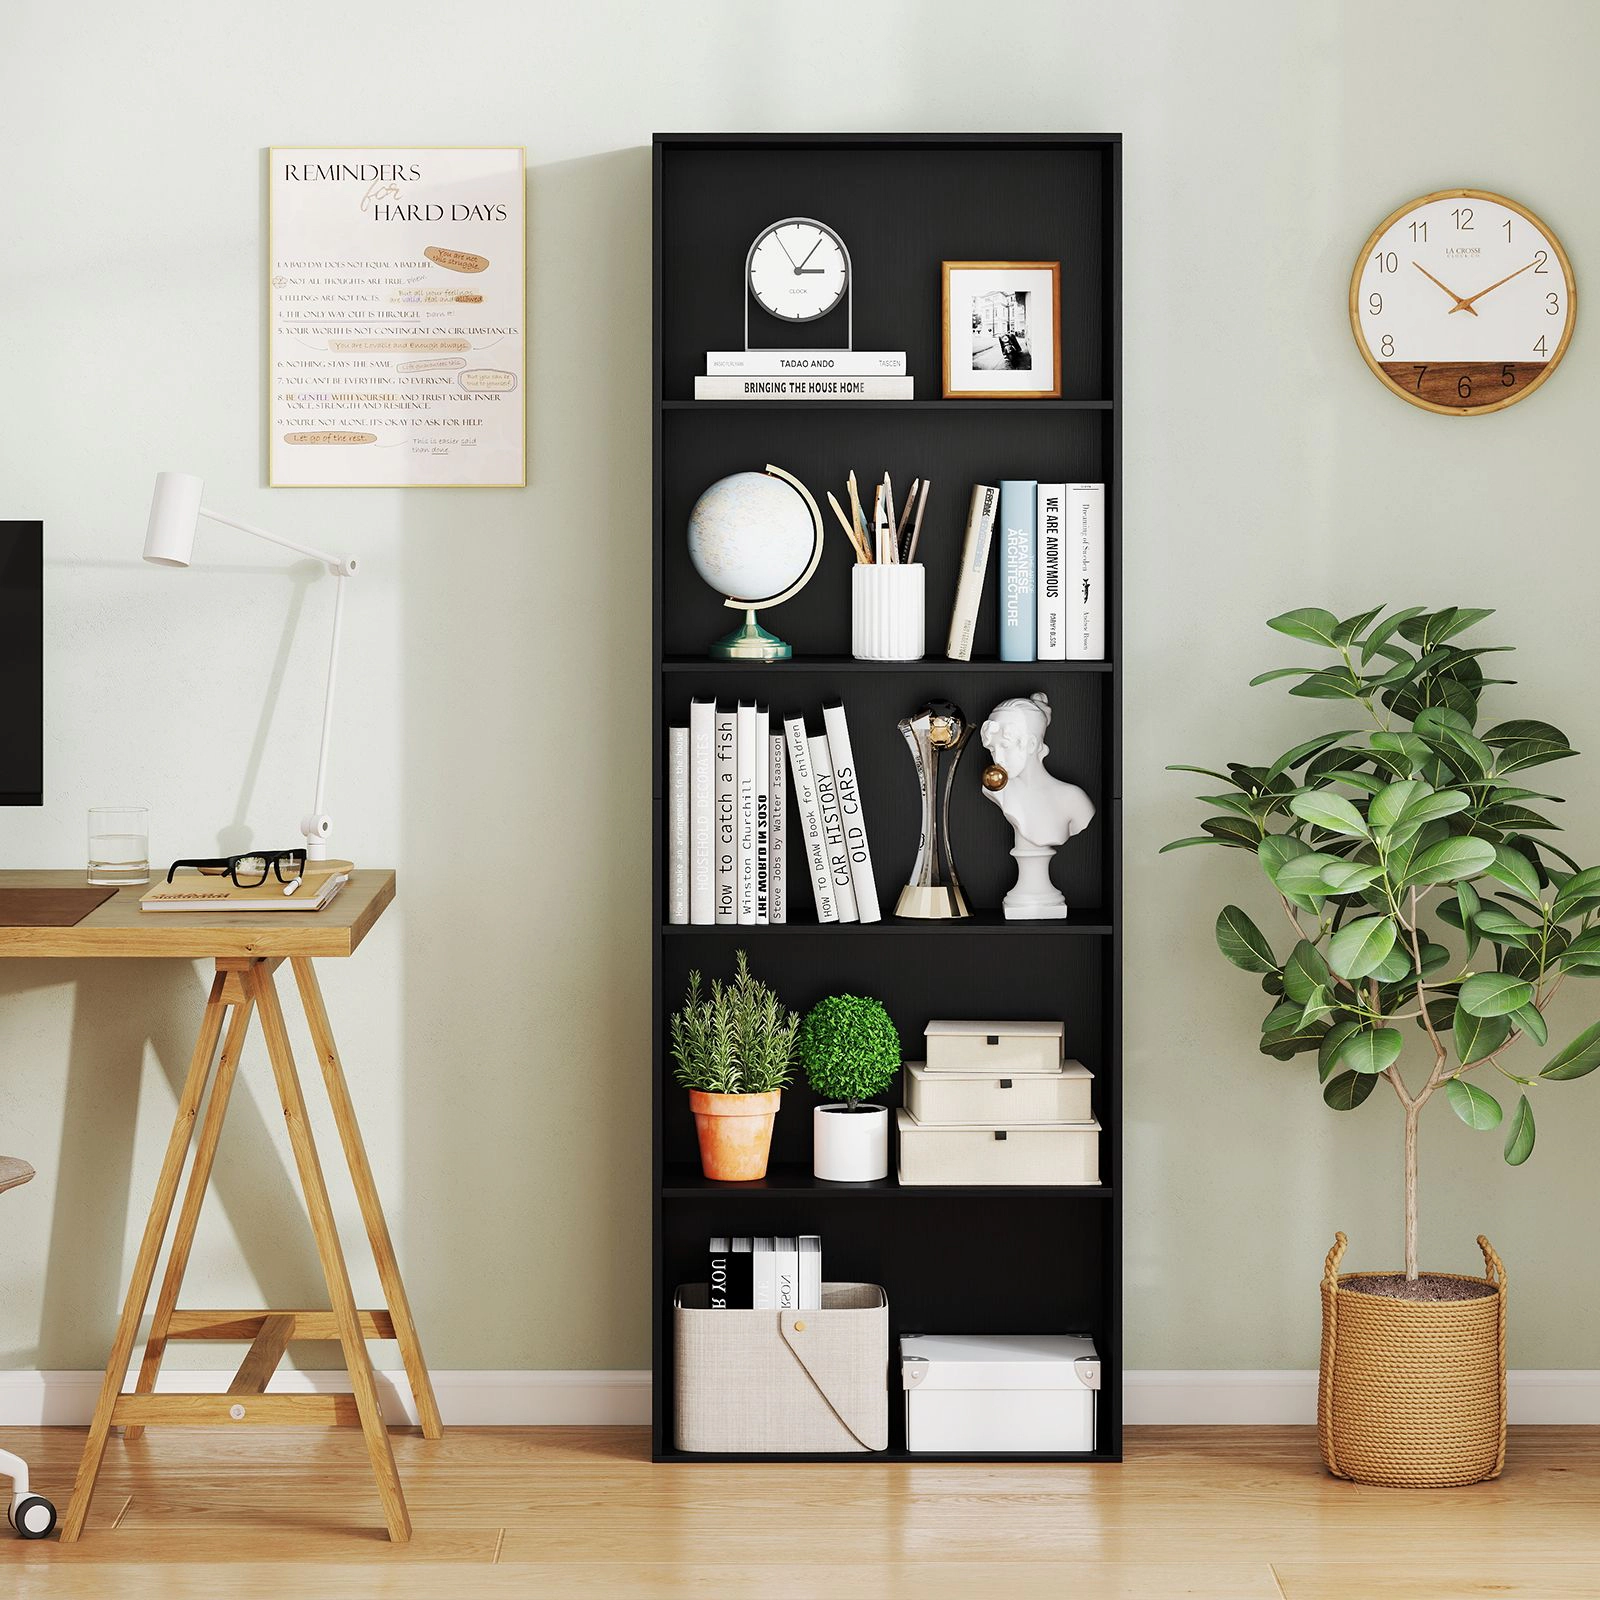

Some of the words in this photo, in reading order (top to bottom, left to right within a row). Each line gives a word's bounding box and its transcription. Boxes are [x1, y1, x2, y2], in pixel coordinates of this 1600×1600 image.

[285, 164, 421, 182] REMINDERS
[360, 180, 404, 212] for
[375, 204, 444, 222] HARD
[451, 204, 508, 222] DAYS
[1451, 208, 1475, 230] 12
[1408, 221, 1427, 243] 11
[1502, 220, 1512, 243] 1
[1374, 252, 1399, 274] 10
[1533, 250, 1549, 274] 2
[1369, 292, 1383, 316] 9
[1545, 292, 1560, 316] 3
[285, 327, 309, 335] YOUR
[354, 327, 372, 335] NOT
[432, 327, 446, 335] ON
[1380, 334, 1395, 357] 8
[1533, 334, 1548, 358] 4
[780, 359, 808, 368] TADAO
[810, 359, 835, 368] ANDO
[879, 359, 901, 367] TASCEN
[285, 377, 303, 385] YOU
[744, 382, 787, 393] BRINGING
[788, 382, 806, 393] THE
[808, 382, 838, 393] HOUSE
[840, 382, 865, 393] HOME
[1413, 365, 1428, 390] 7
[1457, 375, 1472, 399] 6
[1501, 364, 1515, 388] 5
[1046, 497, 1058, 513] WE
[1046, 515, 1058, 534] ARE
[1081, 504, 1090, 537] Dreaming
[1017, 529, 1029, 594] JAPANESE
[1046, 537, 1058, 598] ANONYMOUS
[1007, 528, 1018, 627] ARCHITECTURE
[718, 722, 732, 761] fish
[792, 725, 808, 778] children
[697, 734, 709, 807] DECORATES
[773, 737, 781, 787] Isaacson
[722, 773, 733, 783] a
[803, 786, 812, 803] for
[838, 767, 858, 814] CARS
[718, 793, 732, 844] catch
[742, 778, 752, 850] Churchill
[773, 794, 781, 832] Walter
[817, 773, 843, 845] HISTORY
[806, 811, 819, 837] Book
[697, 816, 709, 890] HOUSEHOLD
[773, 837, 783, 850] by
[848, 827, 866, 863] OLD
[719, 854, 732, 874] to
[773, 857, 781, 881] Jobs
[813, 844, 825, 870] DRAW
[833, 854, 850, 886] CAR
[675, 887, 684, 897] to
[743, 858, 752, 915] Winston
[818, 877, 827, 891] TO
[675, 902, 684, 916] How
[718, 884, 732, 915] How
[773, 889, 781, 919] Steve
[822, 897, 832, 917] HOW
